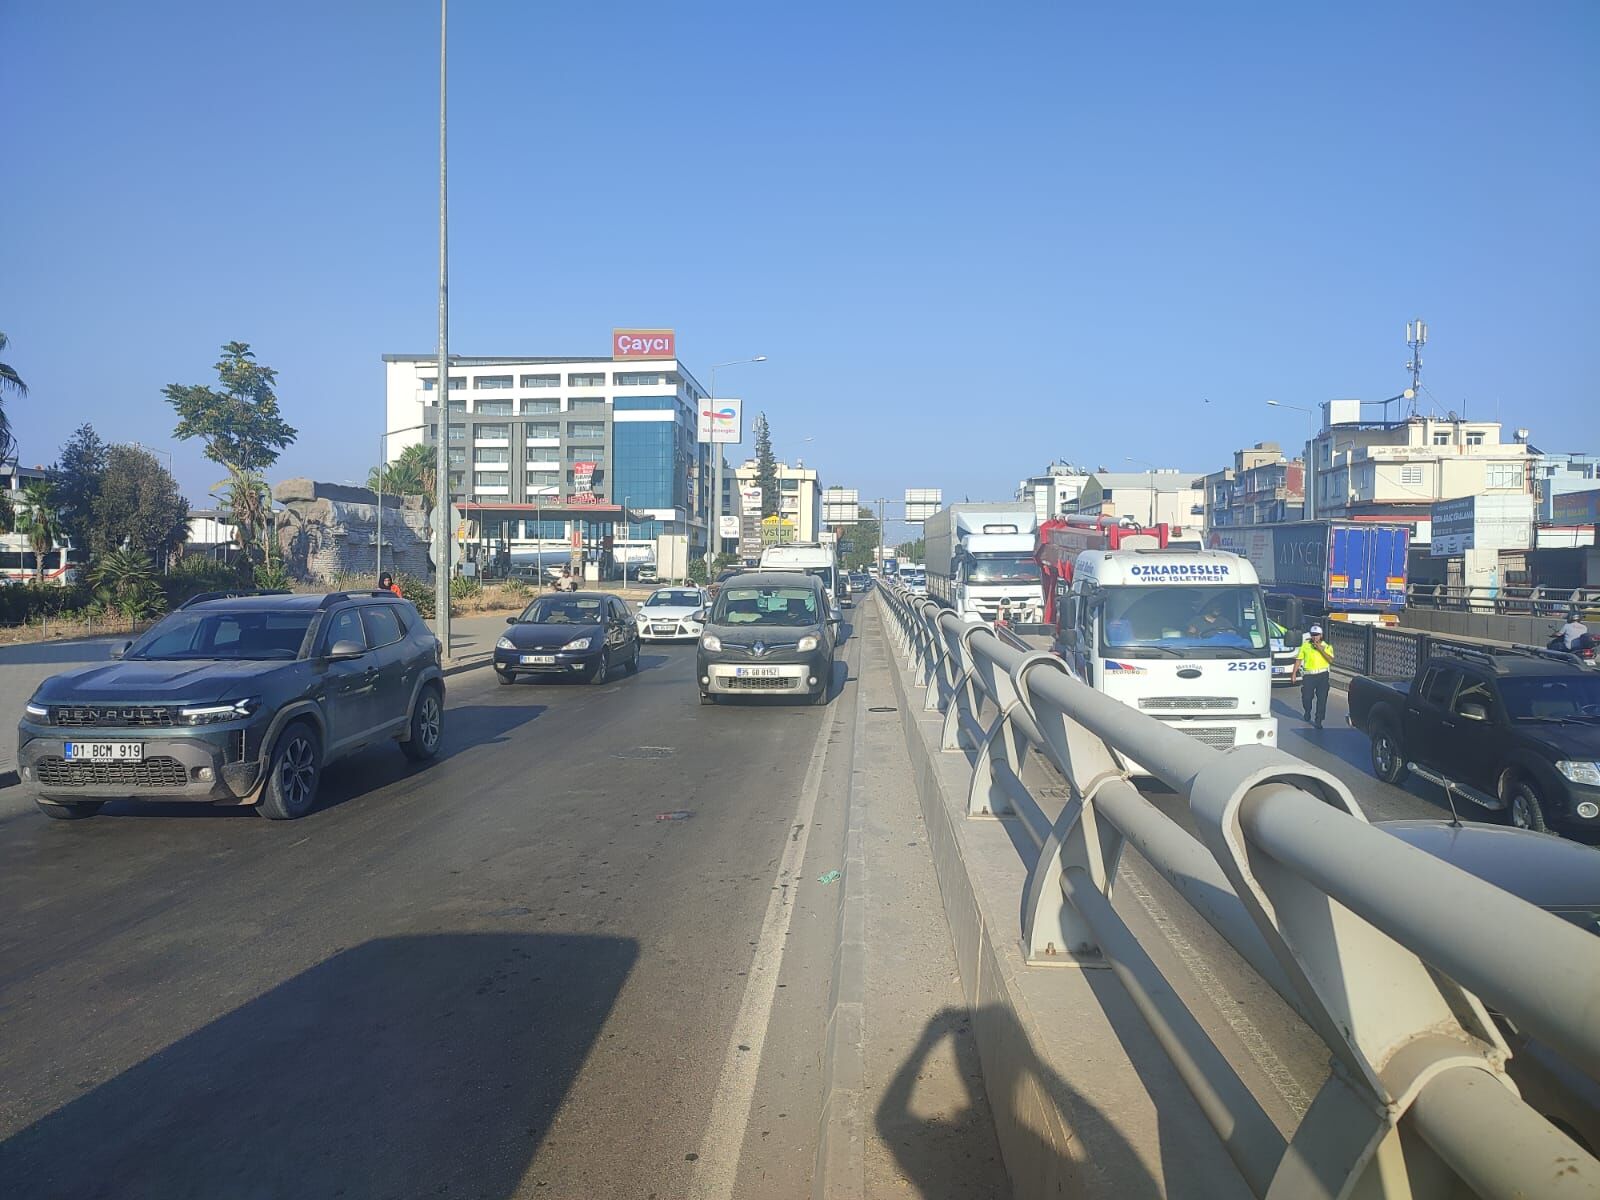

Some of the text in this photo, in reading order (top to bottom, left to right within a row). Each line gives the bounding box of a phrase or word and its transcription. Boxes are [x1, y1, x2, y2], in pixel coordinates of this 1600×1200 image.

[618, 335, 669, 354] Çaycı
[1131, 565, 1229, 576] ÖZKARDEŞLER
[1227, 661, 1267, 672] 2526
[59, 709, 166, 719] RENAULT
[73, 744, 84, 757] 01
[93, 744, 112, 757] BCM
[120, 744, 140, 757] 919
